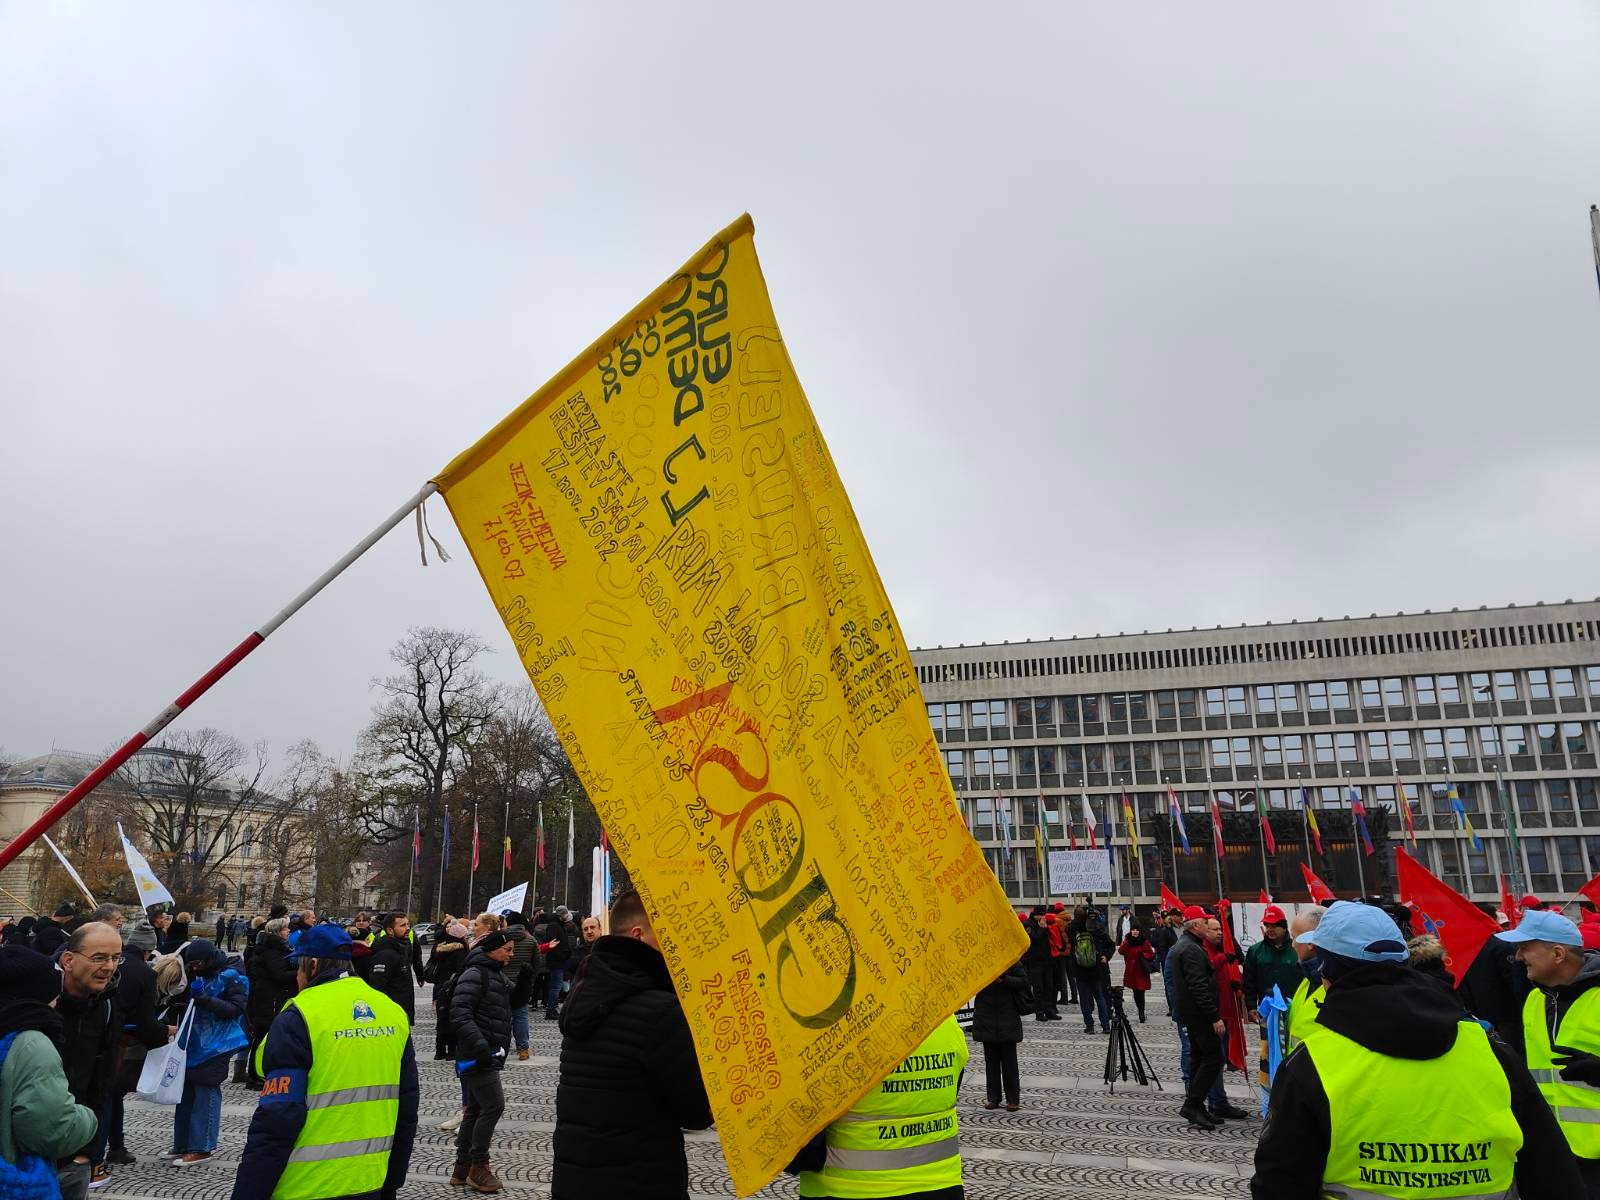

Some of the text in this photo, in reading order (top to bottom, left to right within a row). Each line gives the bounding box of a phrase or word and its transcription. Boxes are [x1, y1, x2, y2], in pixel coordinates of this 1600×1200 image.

[549, 402, 608, 493] REŠITEV
[597, 486, 631, 536] SMO
[567, 390, 607, 455] KRIZA
[600, 449, 633, 492] STE
[501, 495, 538, 557] PRAVICA
[578, 505, 619, 563] 2012
[617, 665, 669, 751] STAVKA
[661, 746, 692, 786] JS
[723, 879, 750, 916] 13
[887, 766, 944, 871] LJUBLJANA
[334, 1026, 395, 1040] PERGAM
[731, 945, 784, 1091] FRANCOSKO
[891, 1051, 955, 1074] INDIKAT
[878, 1116, 953, 1139] ZA OBRAMBO
[1358, 1141, 1491, 1163] SINDIKAT
[1359, 1166, 1491, 1188] MINISTRSTVA
